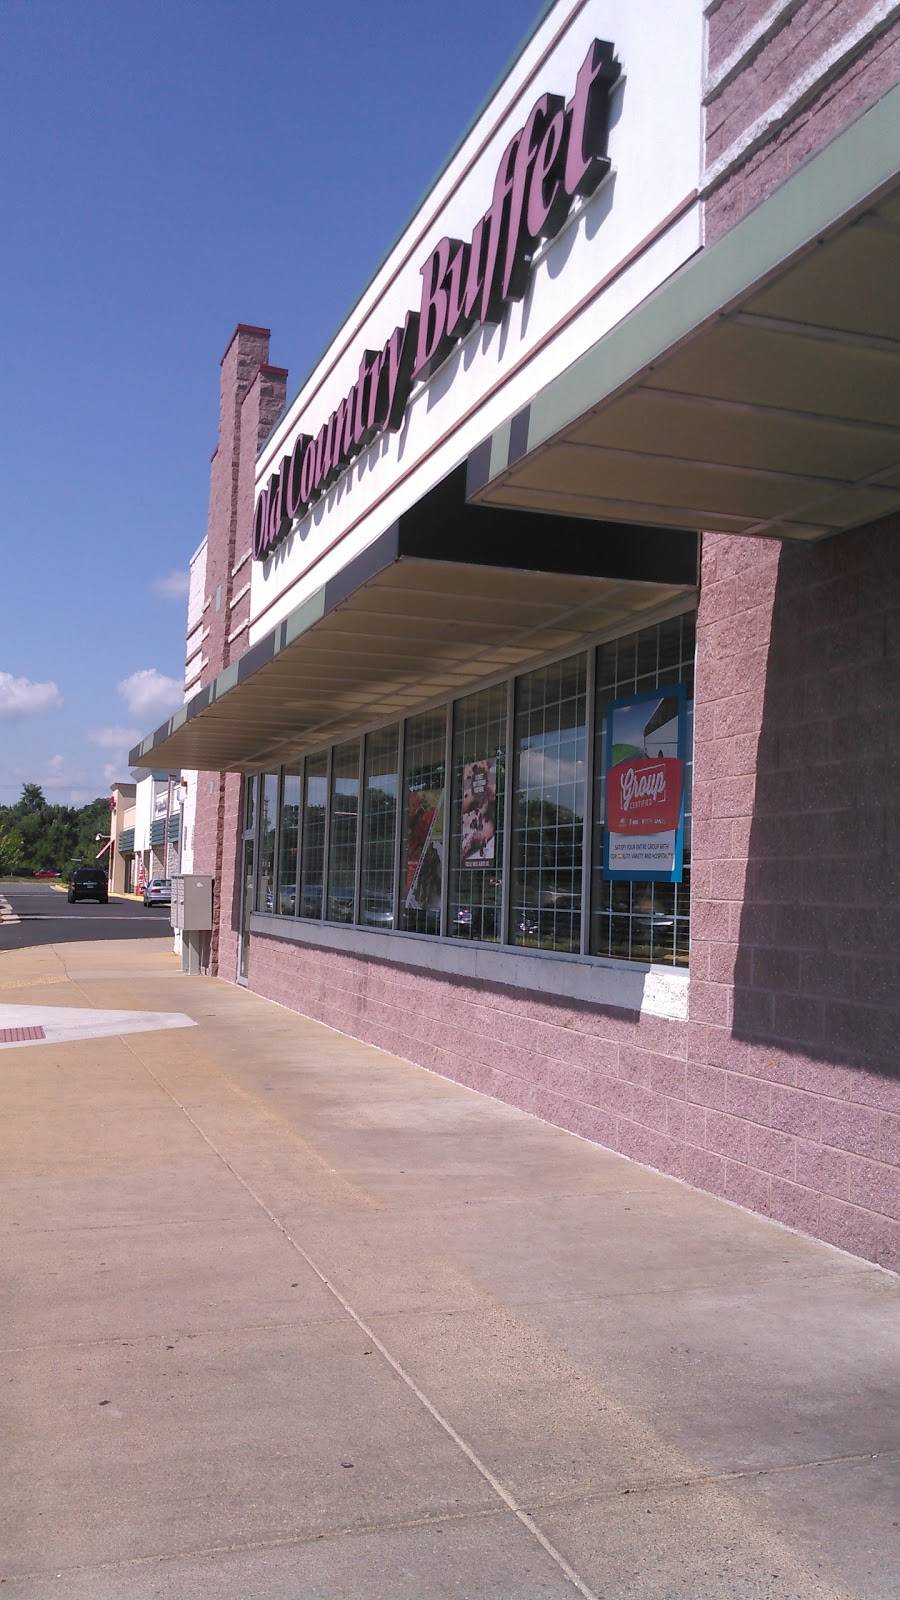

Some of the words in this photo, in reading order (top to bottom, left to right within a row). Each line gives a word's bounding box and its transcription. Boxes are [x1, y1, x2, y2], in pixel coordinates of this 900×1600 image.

[252, 456, 290, 561] Old
[287, 312, 416, 519] Country
[410, 38, 612, 379] Buffet
[620, 767, 666, 811] Group
